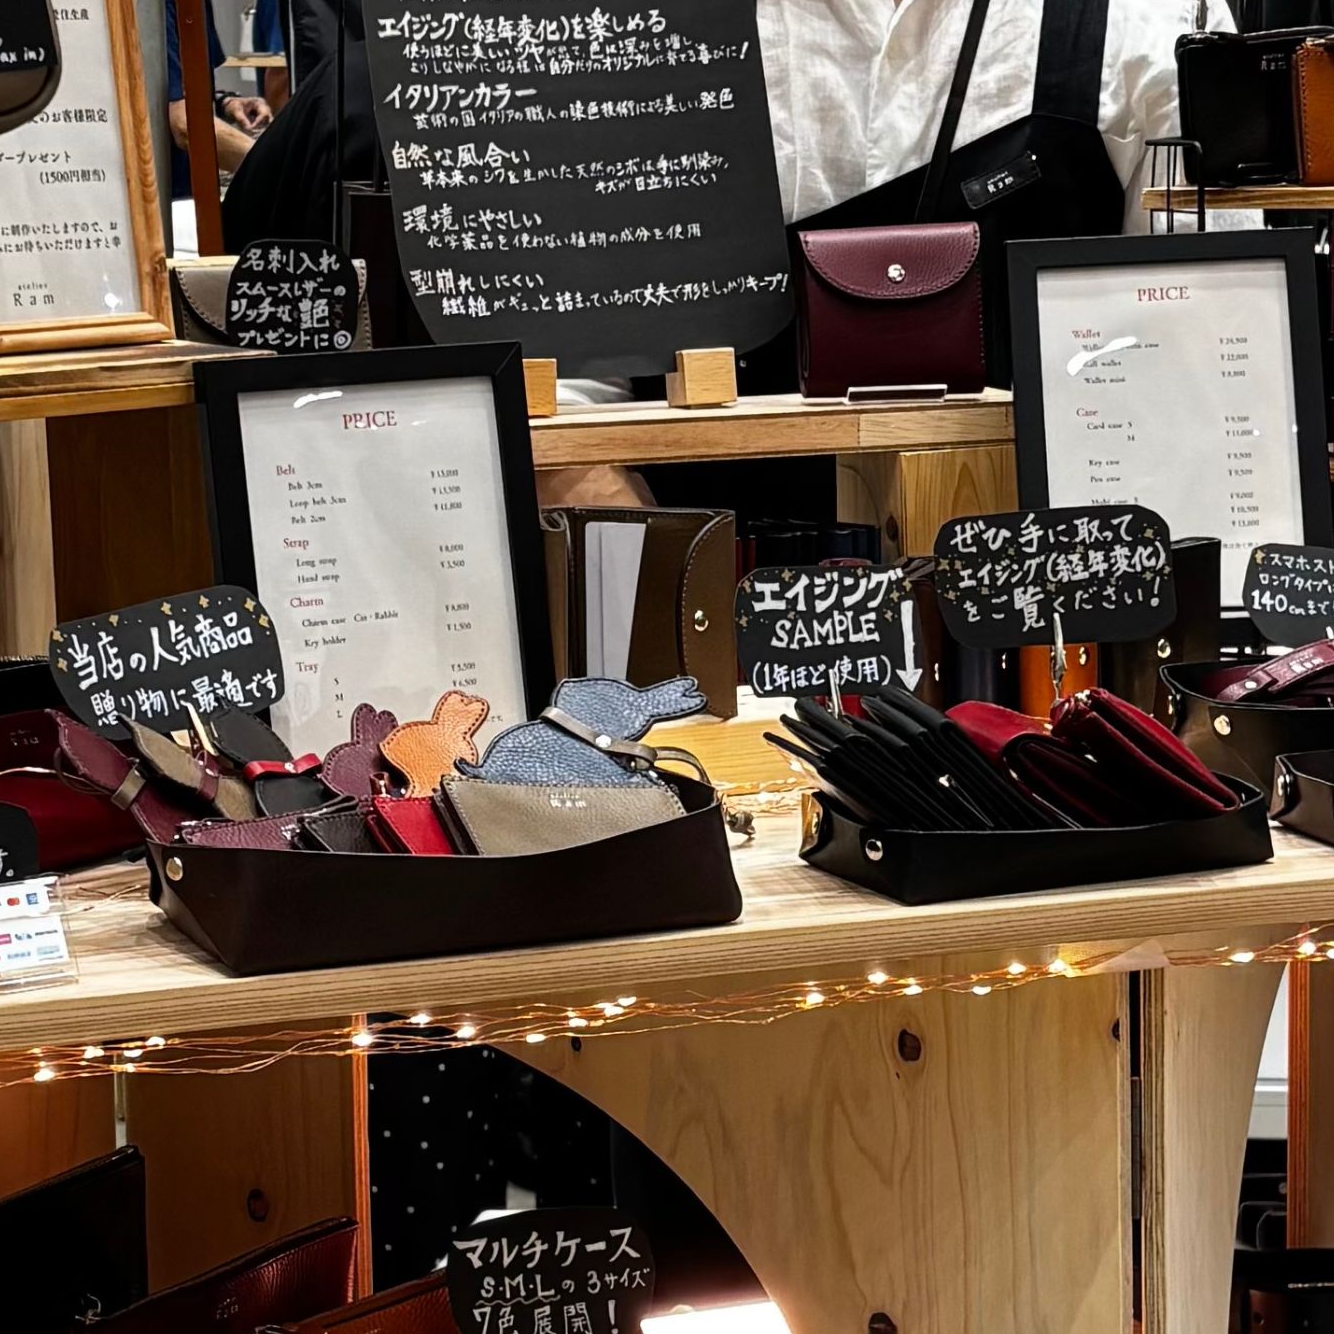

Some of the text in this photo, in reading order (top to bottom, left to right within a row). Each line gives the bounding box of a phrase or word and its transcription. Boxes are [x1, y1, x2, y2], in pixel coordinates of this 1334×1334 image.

[384, 83, 537, 111] イタリアンカラー
[392, 141, 530, 170] 自然な風合い
[402, 204, 542, 234] 環境にやさしい
[242, 245, 340, 274] 名刺入れ
[236, 277, 346, 298] スムースレザーの
[410, 268, 543, 296] 型崩れしにくい
[1137, 286, 1190, 302] PRICE
[13, 293, 55, 307] Ram
[231, 297, 329, 329] リッチな艶
[1072, 330, 1101, 339] Wallet
[342, 410, 397, 430] PRICE
[1076, 407, 1099, 417] Case
[949, 513, 1134, 554] ぜひ手に取って
[290, 597, 324, 609] Charm
[751, 568, 904, 613] エイジング
[770, 611, 880, 651] SAMPLE
[68, 612, 254, 691] 当店の人気商品
[296, 661, 318, 673] Tray
[90, 668, 278, 727] 贈り物に最適です
[453, 1225, 641, 1268] マルチケース
